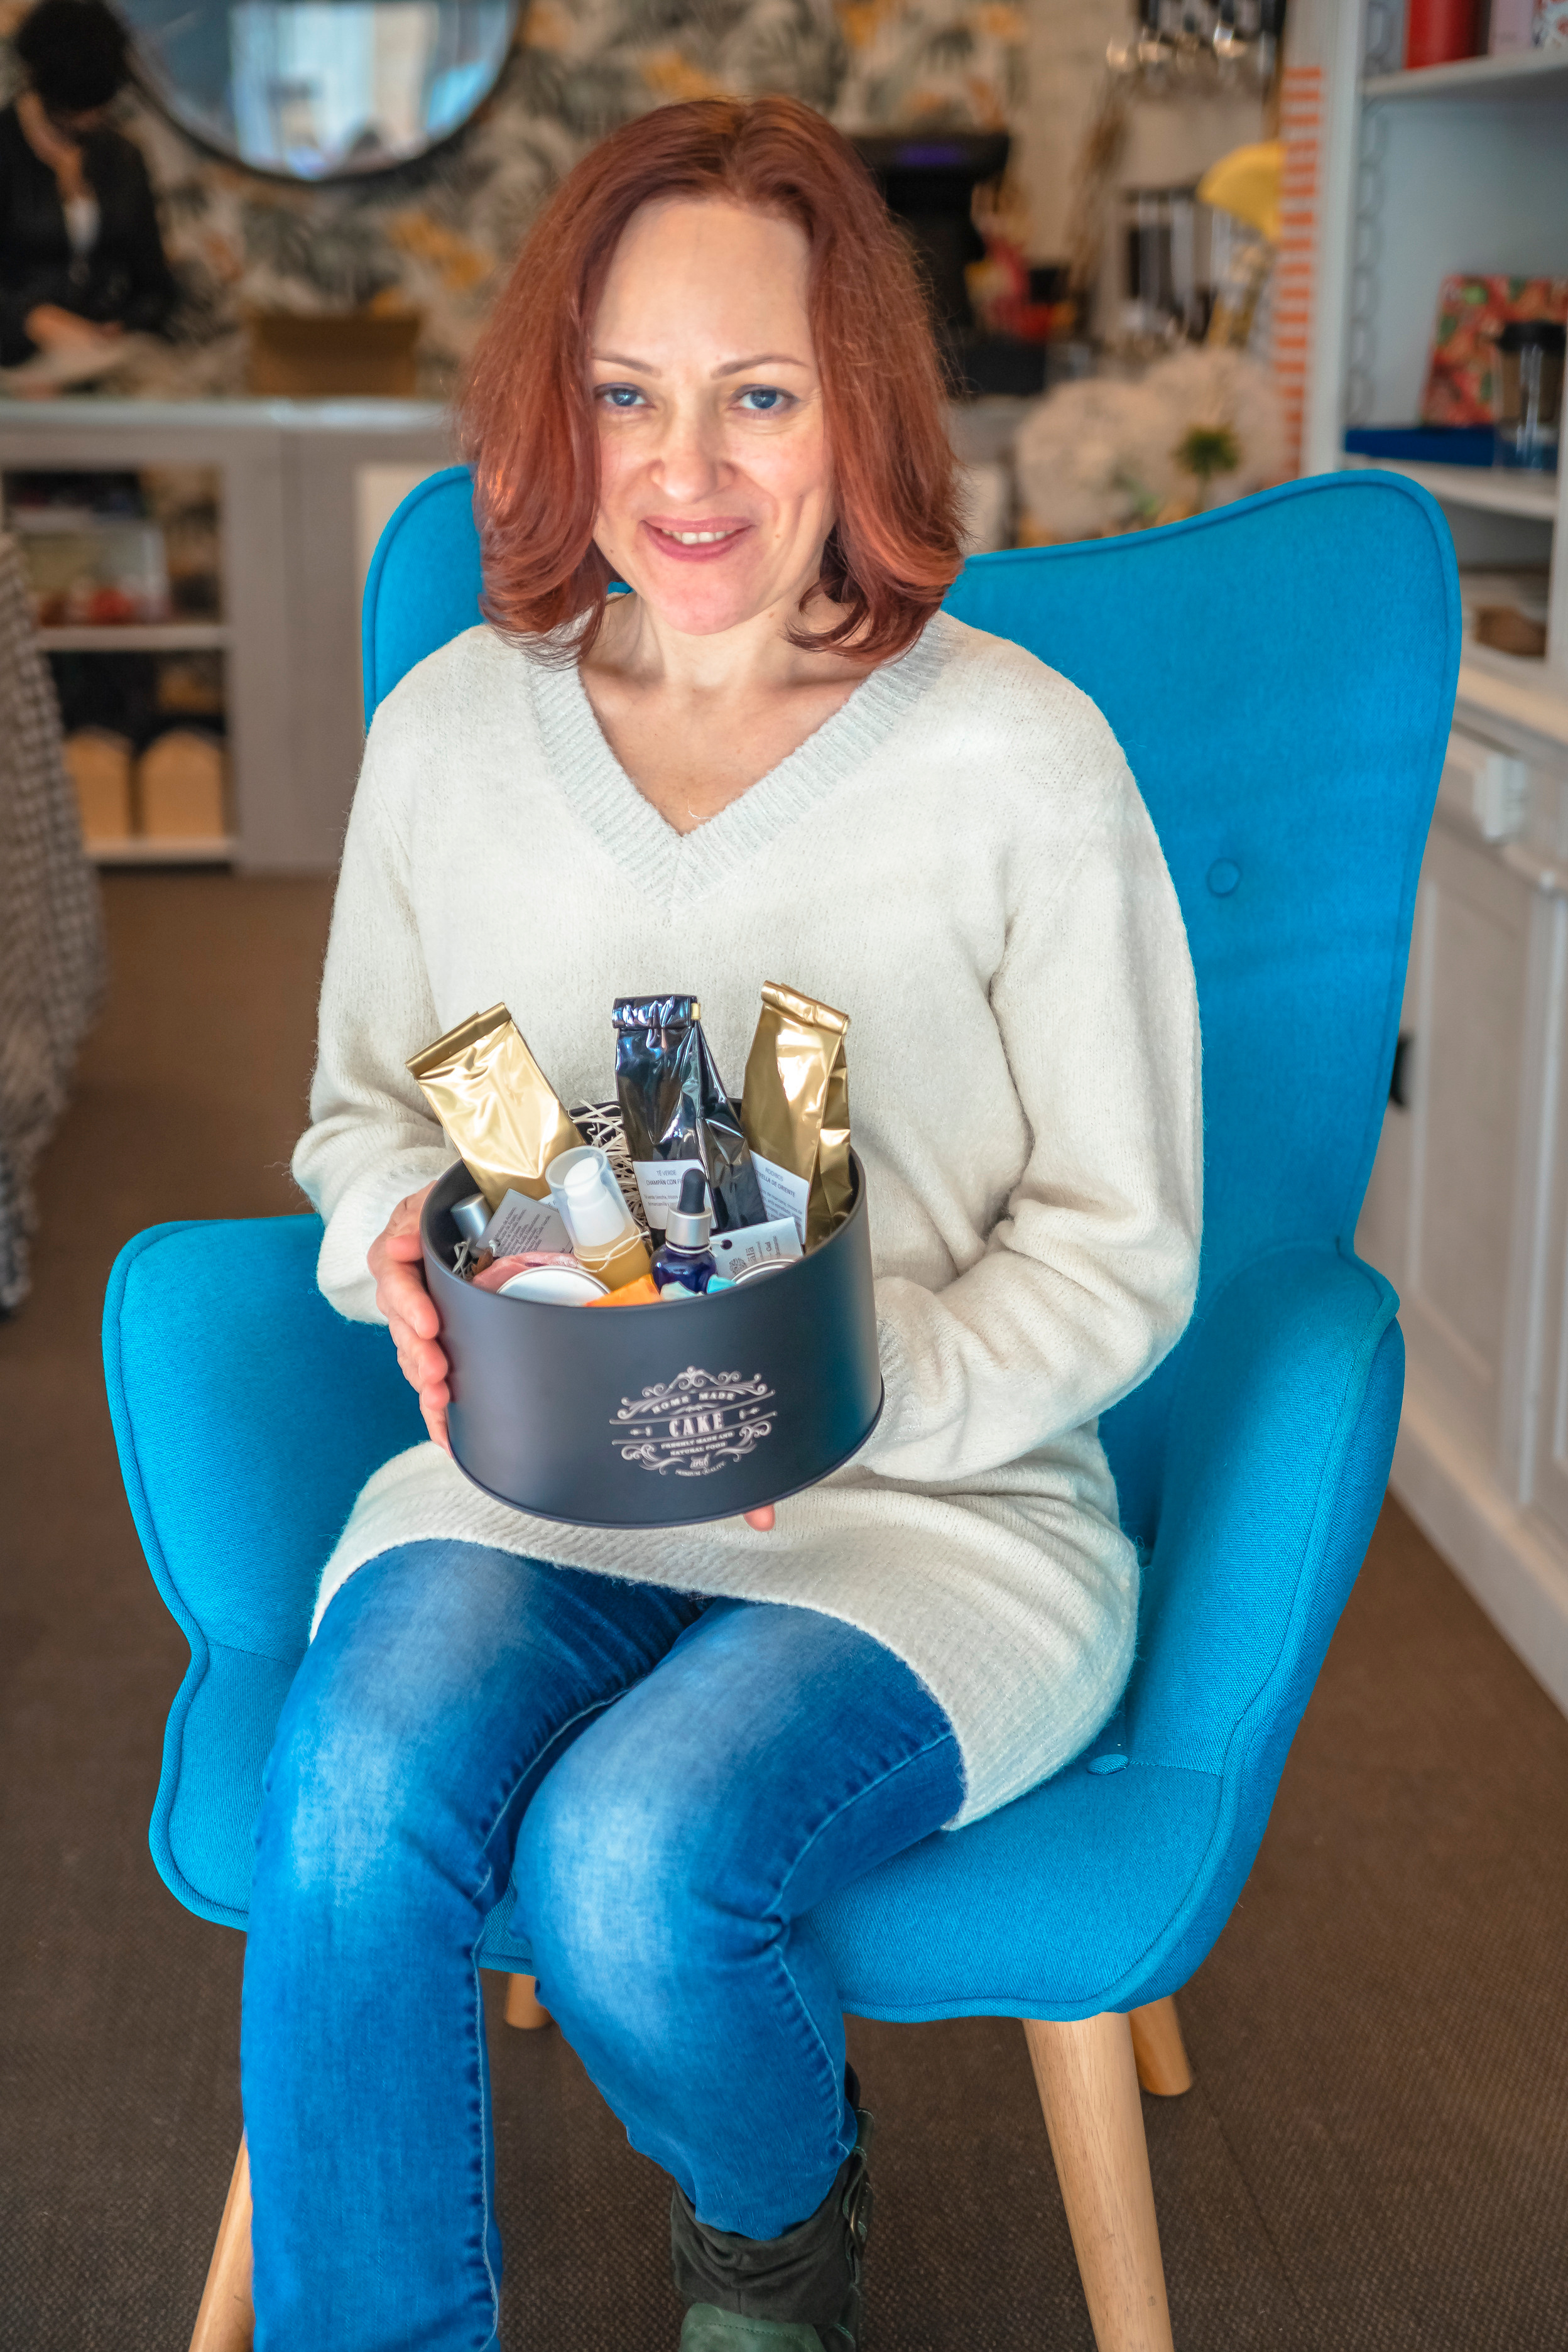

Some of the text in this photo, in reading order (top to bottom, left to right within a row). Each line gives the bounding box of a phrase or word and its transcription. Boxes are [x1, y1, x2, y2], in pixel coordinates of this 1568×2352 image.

[754, 1170, 771, 1184] STRELLA
[778, 1184, 795, 1197] ORIENTE
[765, 1167, 783, 1182] ROOIBOS
[652, 1391, 736, 1414] HOME MADE
[669, 1412, 724, 1438] CAKE
[661, 1431, 734, 1449] FRESHLY MADE AND
[670, 1441, 727, 1456] NATURAL FOOD
[702, 1461, 726, 1476] QUALITY
